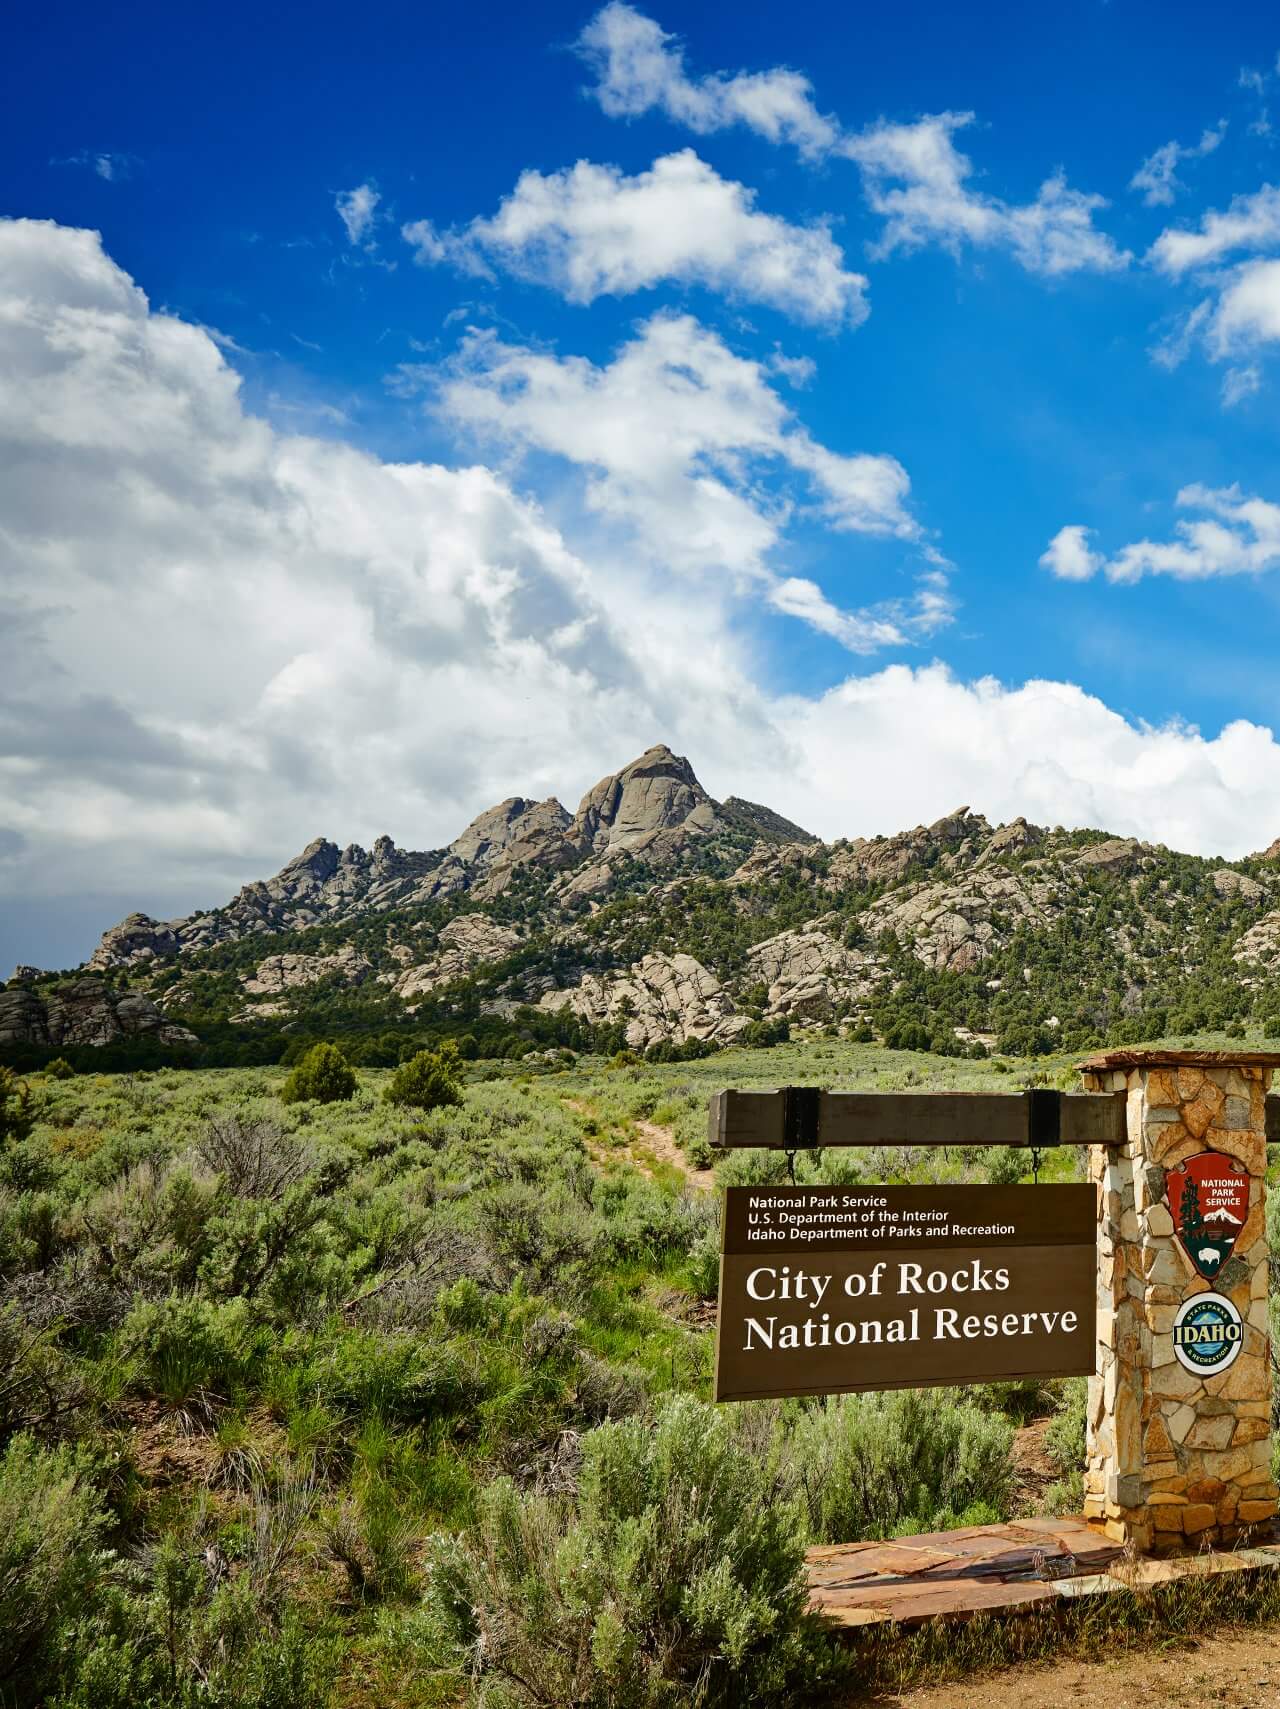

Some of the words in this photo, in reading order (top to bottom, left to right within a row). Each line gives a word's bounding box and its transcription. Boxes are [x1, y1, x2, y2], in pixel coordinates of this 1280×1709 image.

[1201, 1179, 1245, 1188] NATIONAL
[1211, 1188, 1235, 1197] PARK
[750, 1196, 805, 1208] National
[810, 1196, 837, 1207] Park
[843, 1196, 886, 1207] Service
[1205, 1197, 1241, 1206] SERVICE
[749, 1213, 773, 1224] U.S.
[780, 1213, 857, 1225] Department
[861, 1211, 874, 1222] of
[878, 1211, 899, 1221] the
[903, 1210, 948, 1221] Interior
[748, 1228, 785, 1240] Idaho
[791, 1226, 868, 1241] Department
[872, 1226, 885, 1237] of
[889, 1225, 921, 1236] Parks
[926, 1225, 948, 1236] and
[953, 1224, 1014, 1235] Recreation
[747, 1267, 832, 1308] City
[845, 1263, 886, 1296] of
[897, 1260, 1009, 1294] Rocks
[1187, 1304, 1207, 1320] STATE
[1208, 1304, 1228, 1319] PARKS
[743, 1308, 920, 1350] National
[933, 1309, 1077, 1339] Reserve
[1176, 1323, 1240, 1344] IDAHO
[1191, 1346, 1229, 1363] RECREATION
